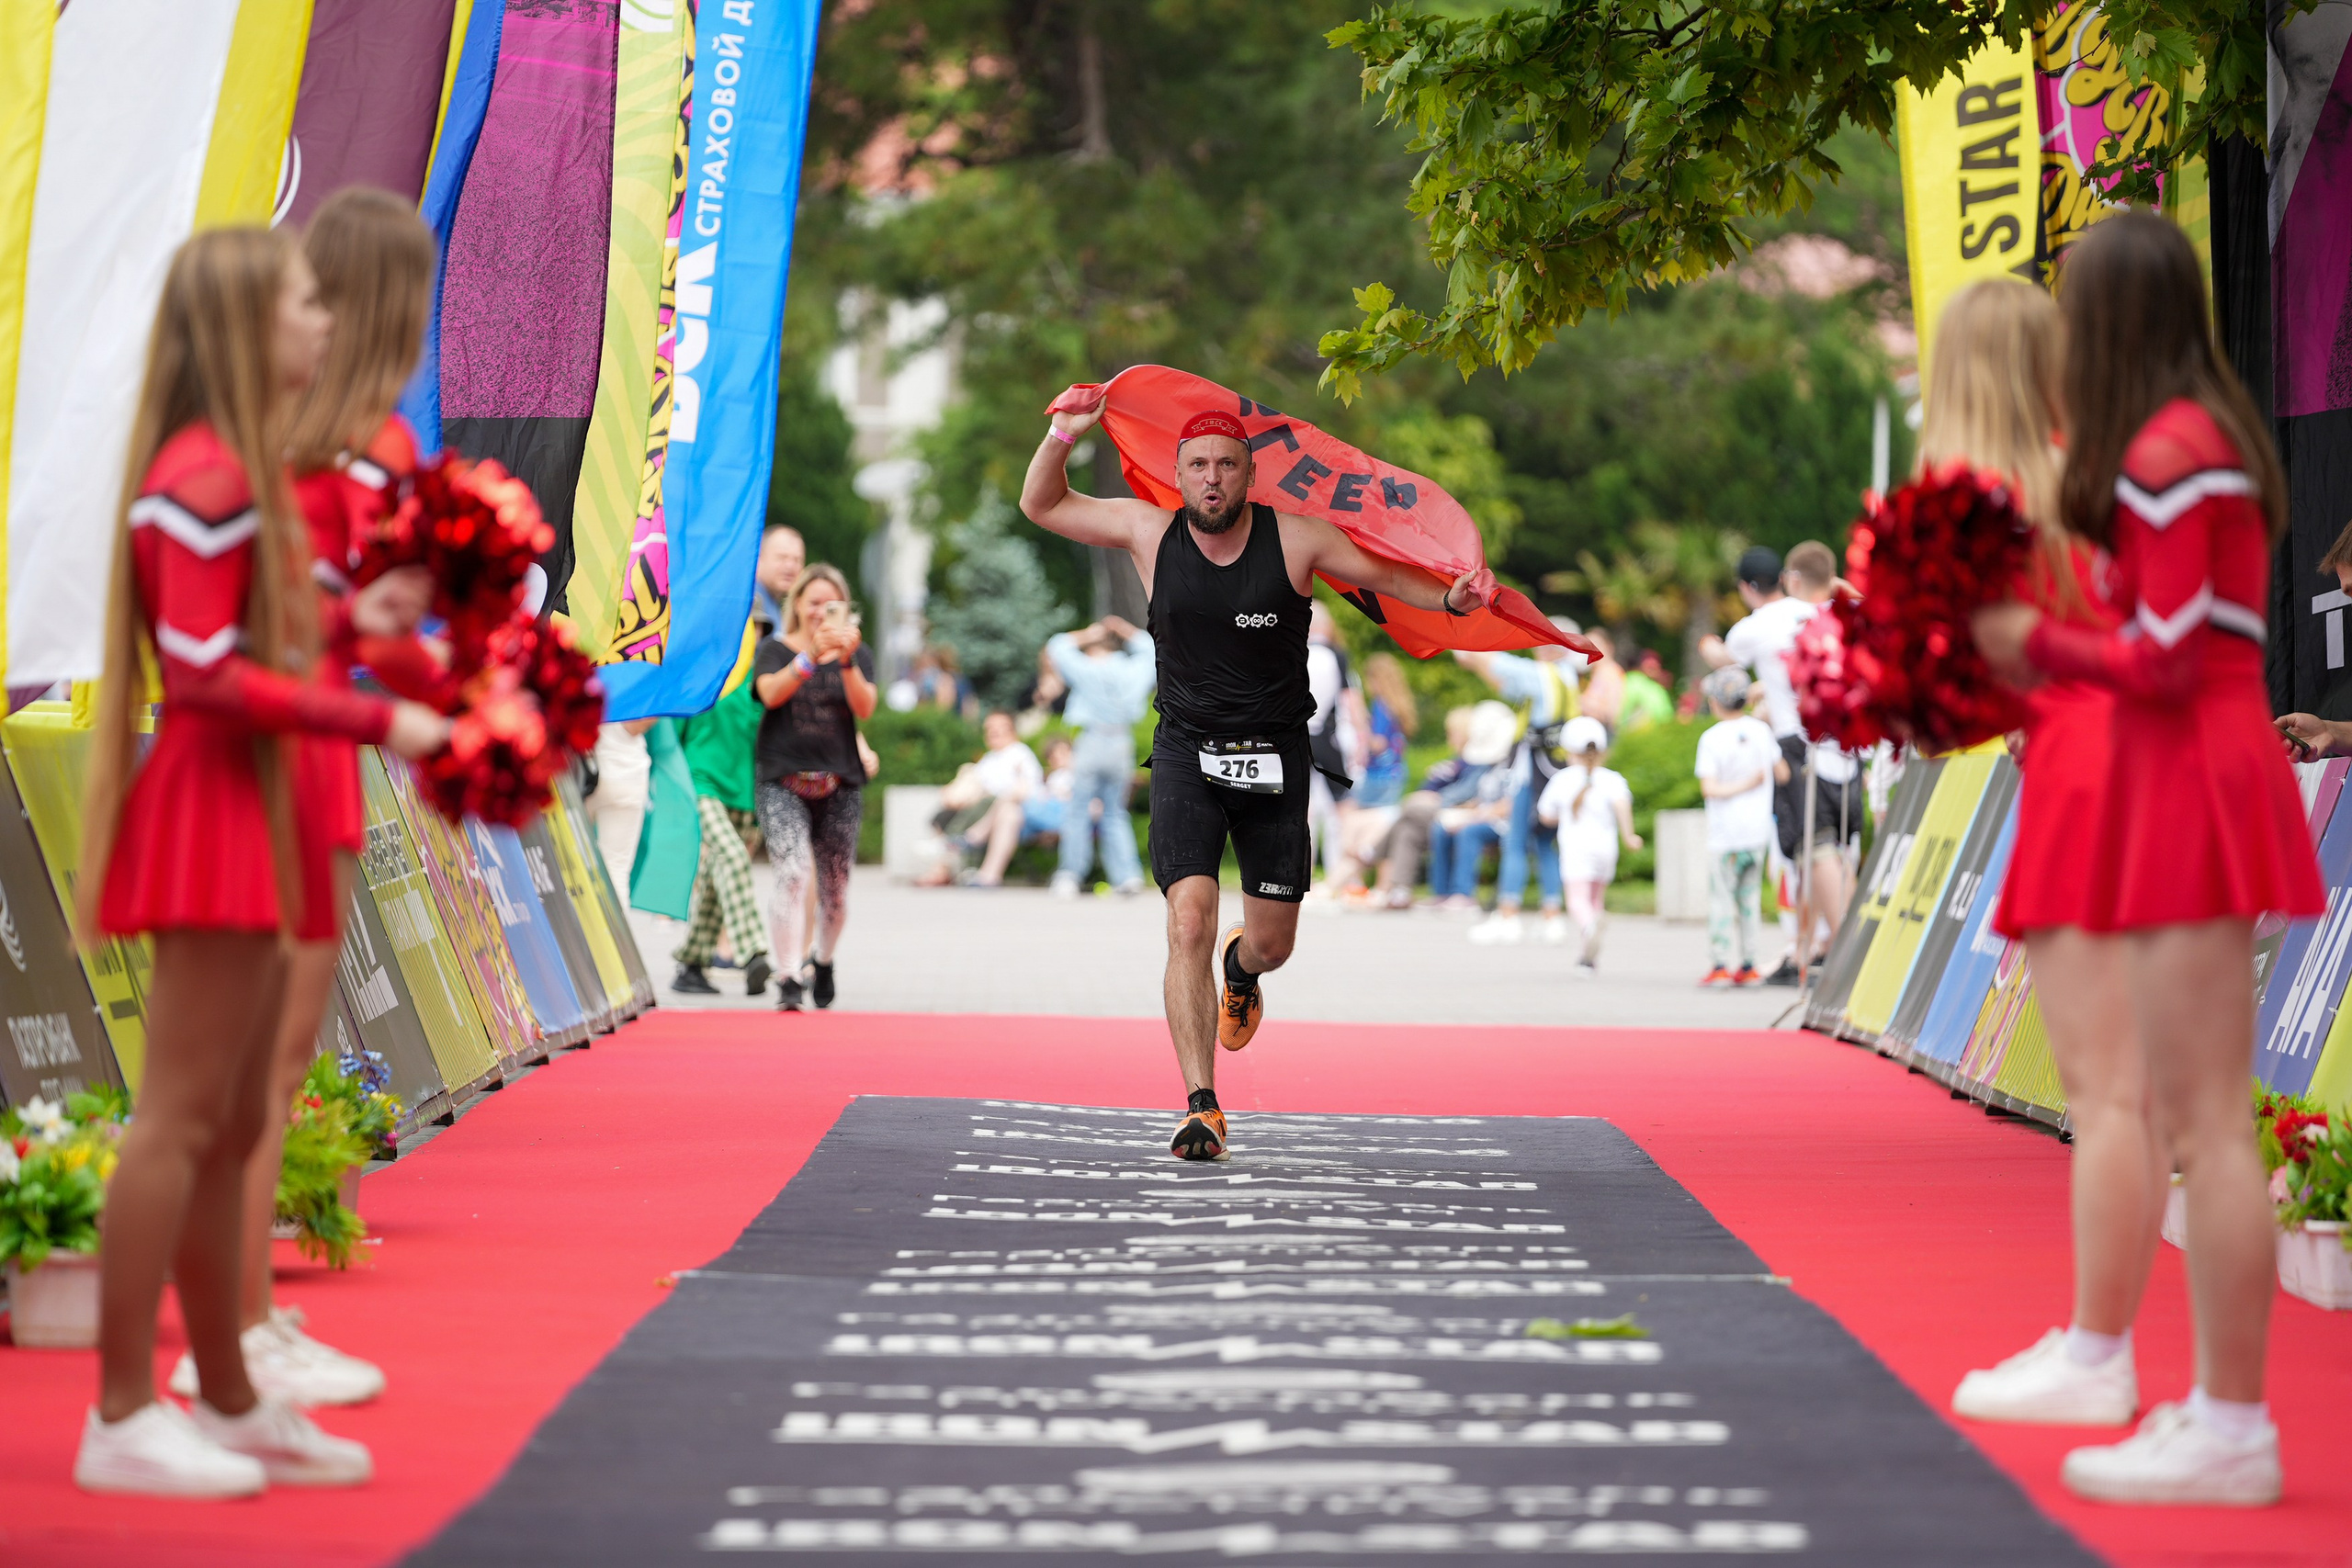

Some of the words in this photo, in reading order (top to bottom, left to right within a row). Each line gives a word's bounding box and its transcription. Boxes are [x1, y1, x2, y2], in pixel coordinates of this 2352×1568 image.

[694, 33, 746, 238] СТРАХОВОЙ
[1956, 76, 2023, 260] STAR
[1219, 760, 1260, 779] 276
[1230, 781, 1251, 789] SERGEY
[955, 1164, 1179, 1179] IRON
[1300, 1176, 1538, 1190] STAR
[930, 1207, 1173, 1220] IRON
[1307, 1216, 1566, 1231] STAR
